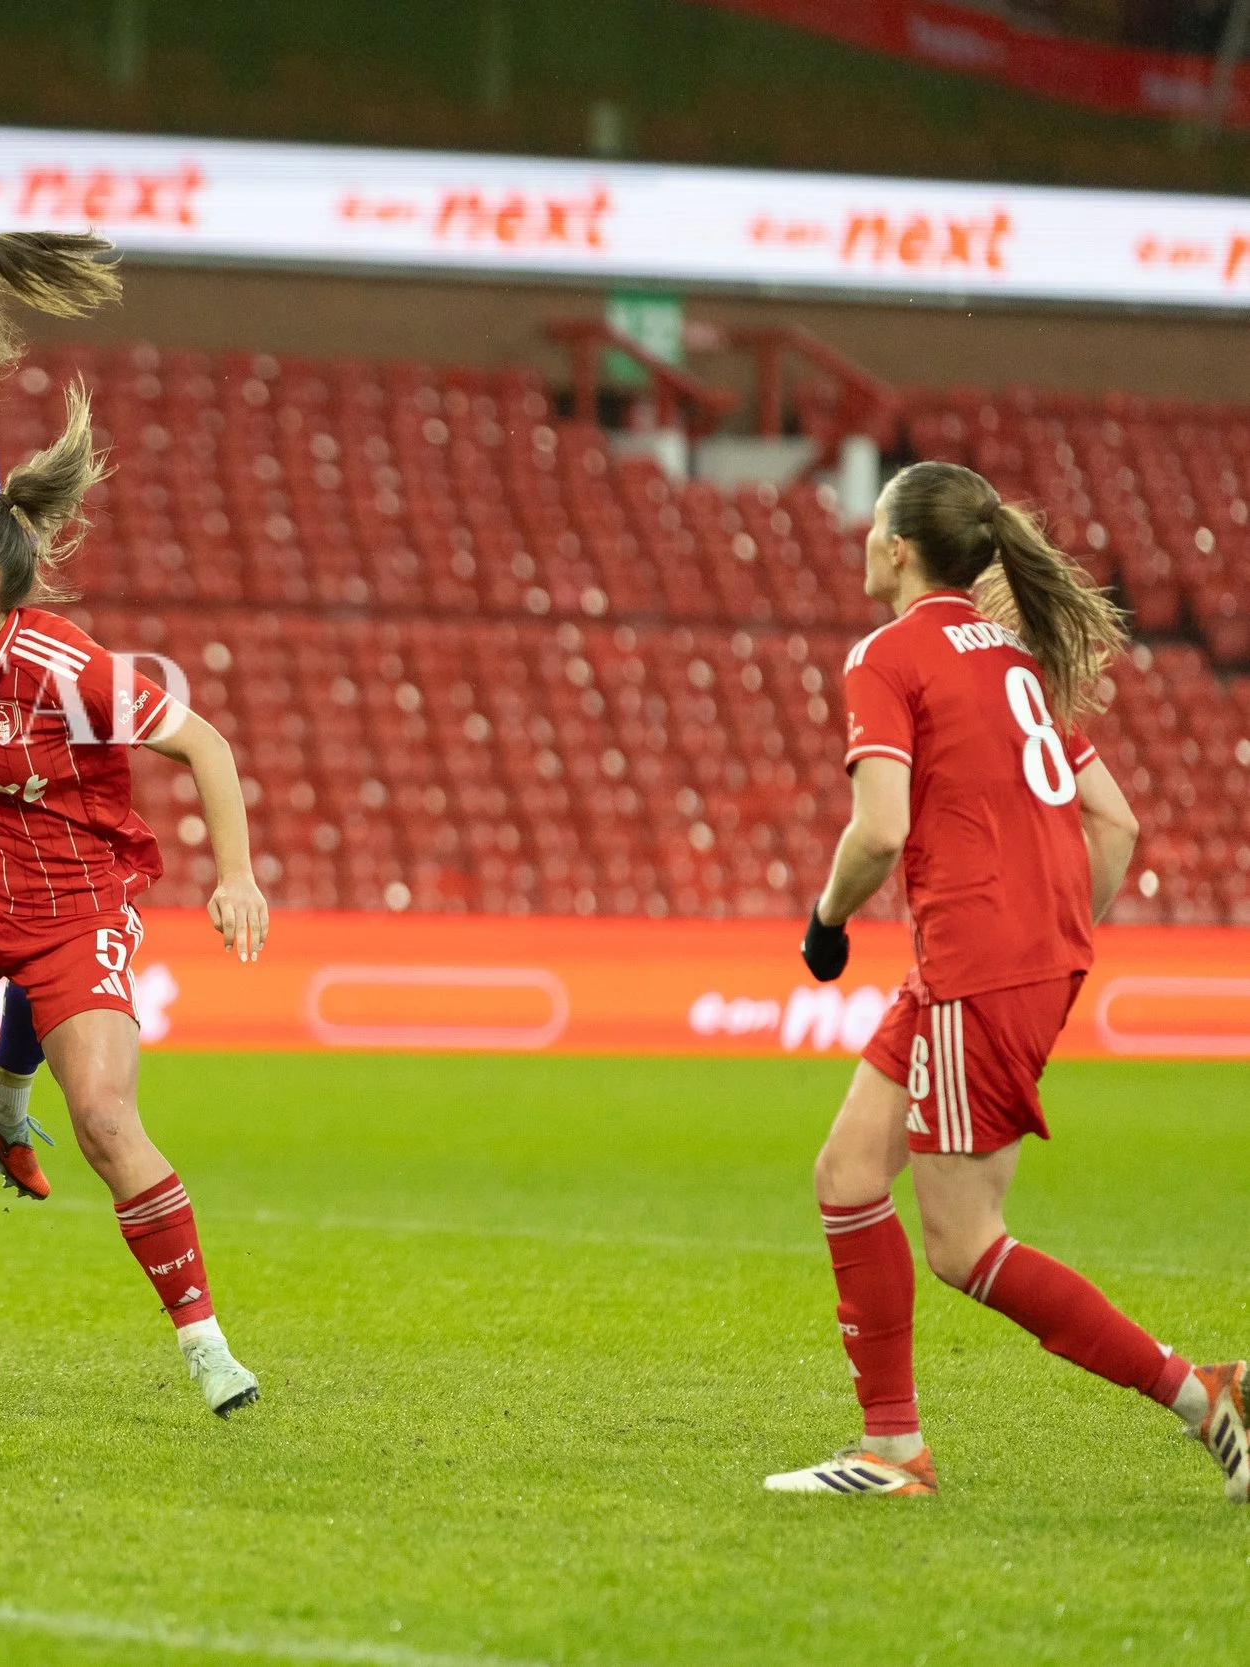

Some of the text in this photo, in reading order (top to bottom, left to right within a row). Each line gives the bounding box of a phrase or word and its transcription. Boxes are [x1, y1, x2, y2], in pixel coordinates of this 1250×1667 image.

[17, 160, 206, 227] next
[432, 182, 612, 252] next
[838, 206, 1012, 275] next
[118, 689, 151, 725] ideagen
[1005, 666, 1077, 806] 8
[95, 929, 128, 972] 5
[780, 985, 901, 1053] ne
[908, 1034, 930, 1100] 8
[149, 1248, 195, 1275] NFFC
